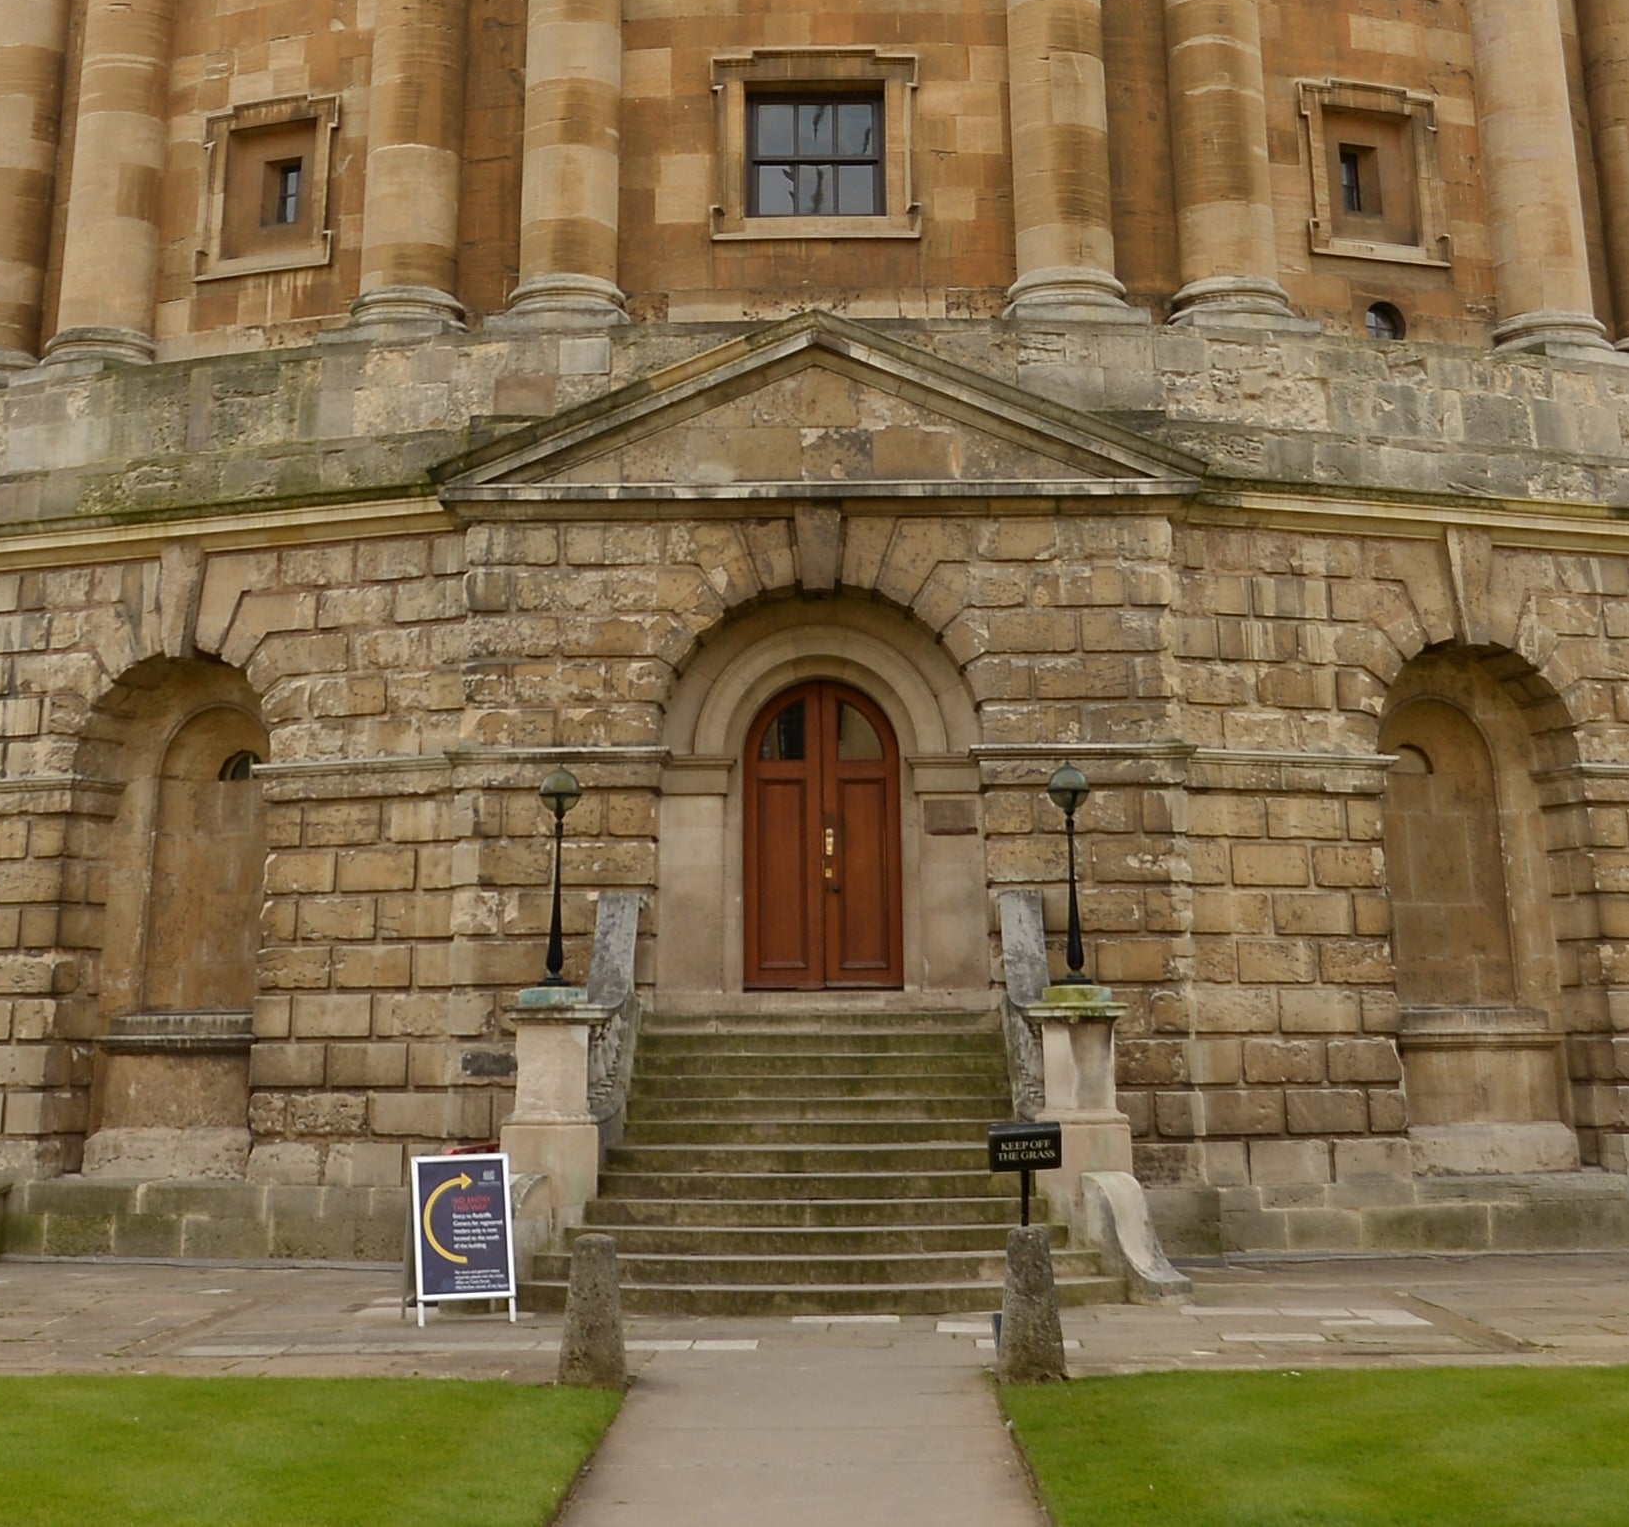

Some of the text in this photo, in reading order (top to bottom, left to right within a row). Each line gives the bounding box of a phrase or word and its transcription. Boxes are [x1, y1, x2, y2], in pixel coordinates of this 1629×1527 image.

[1000, 1139, 1052, 1151] KEEP OFF
[996, 1149, 1056, 1161] THE GRASS
